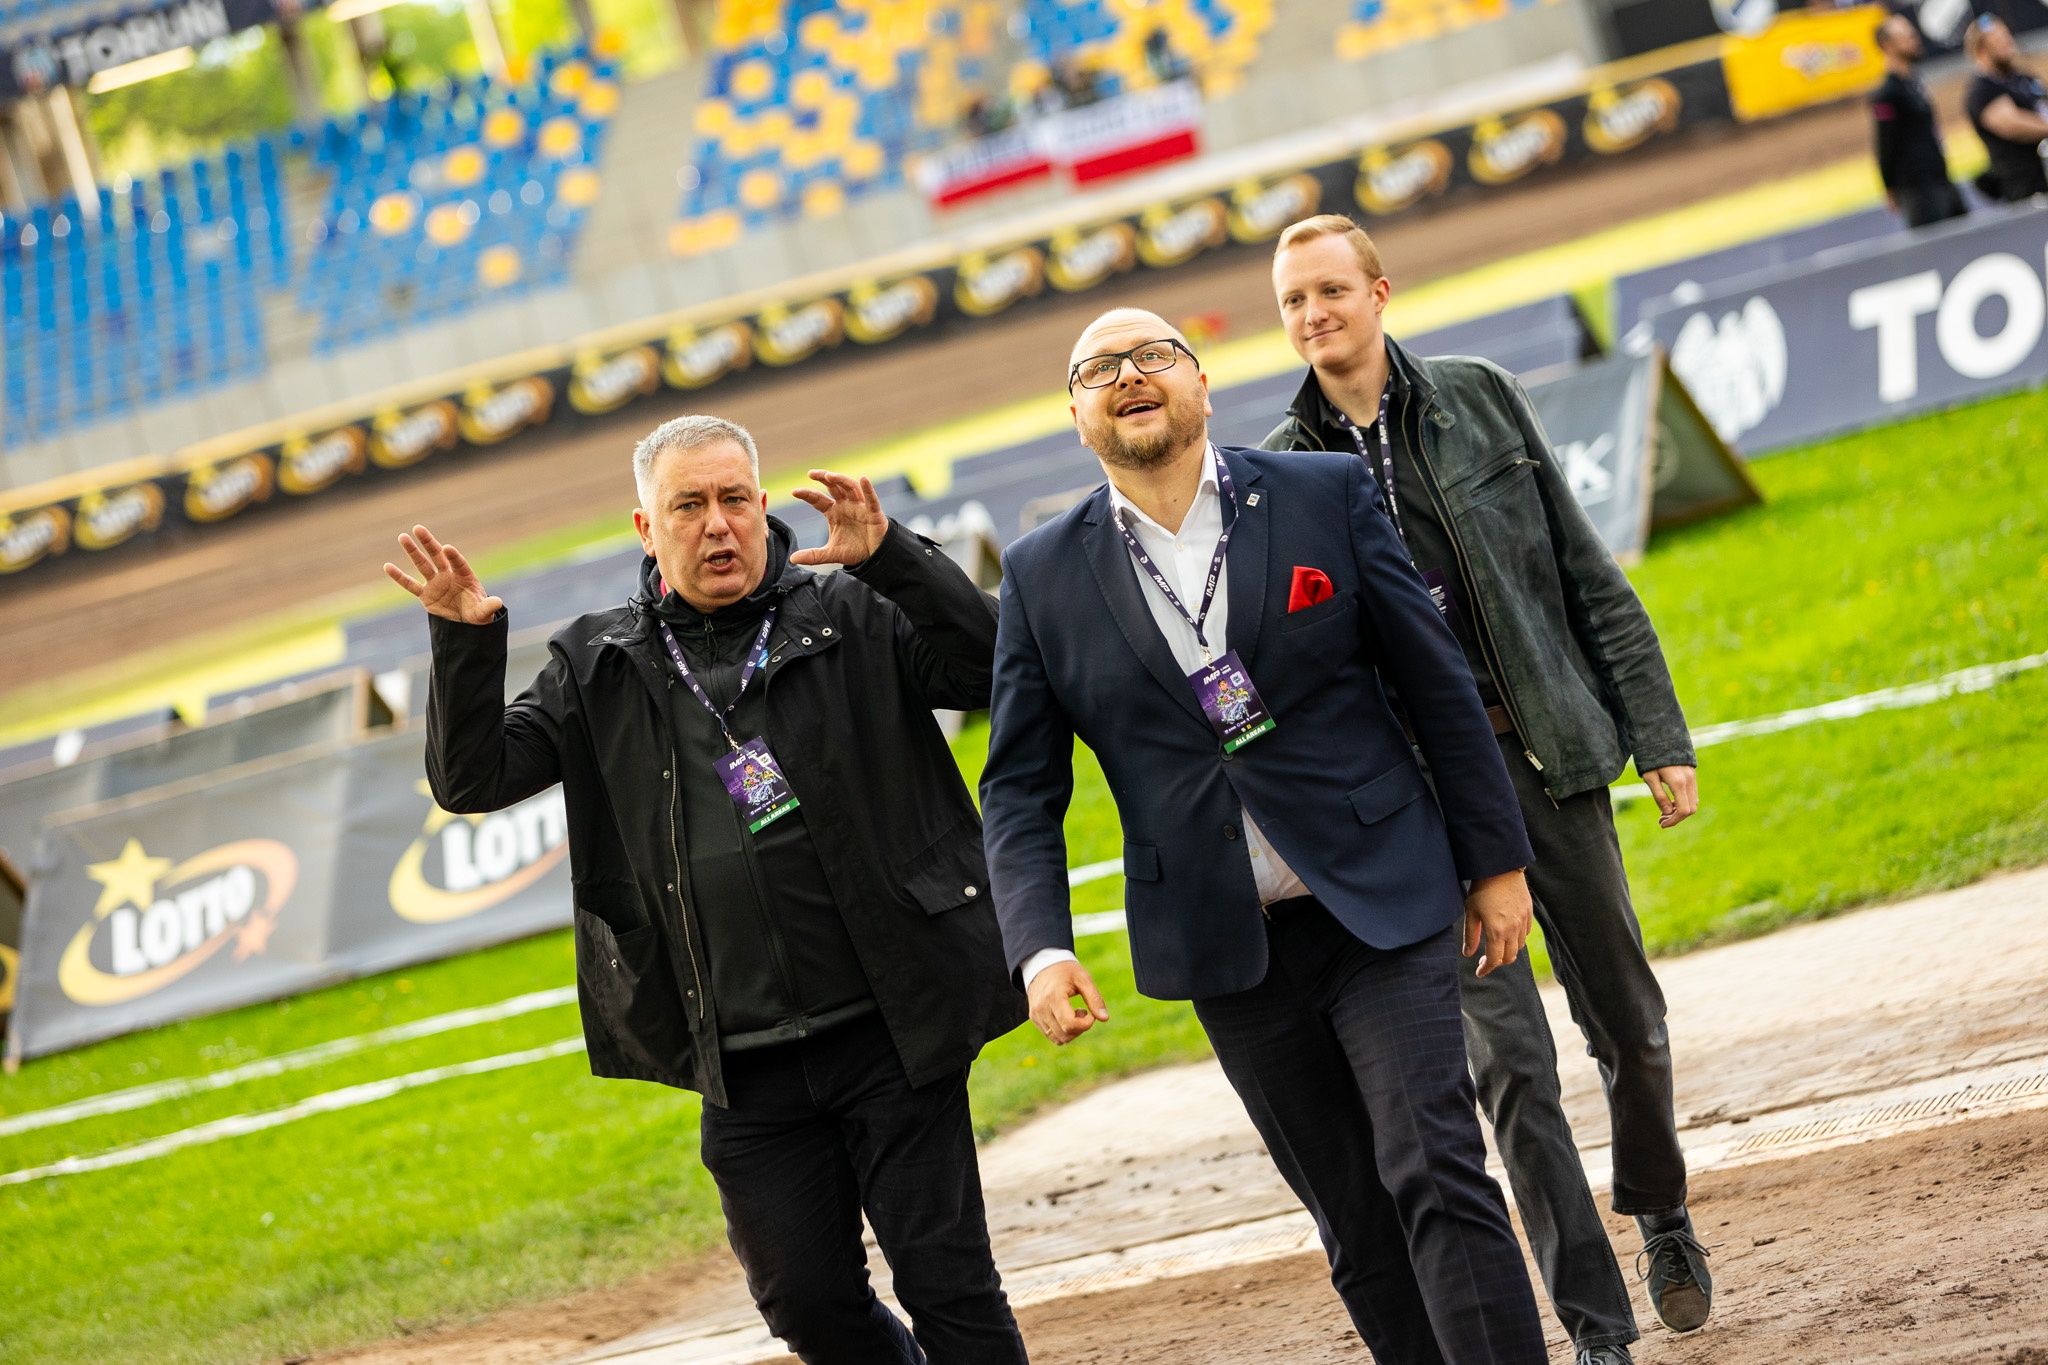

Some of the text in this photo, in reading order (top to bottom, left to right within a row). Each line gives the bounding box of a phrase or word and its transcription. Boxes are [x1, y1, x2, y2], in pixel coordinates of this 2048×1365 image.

[1848, 246, 2048, 403] TO
[1153, 574, 1171, 593] IMP
[1205, 574, 1216, 598] IMP
[761, 619, 772, 639] IMP
[676, 660, 689, 677] IMP
[1203, 669, 1221, 686] IMP
[729, 755, 746, 771] IMP
[441, 789, 568, 891] LOTT
[110, 864, 256, 975] LOTTO
